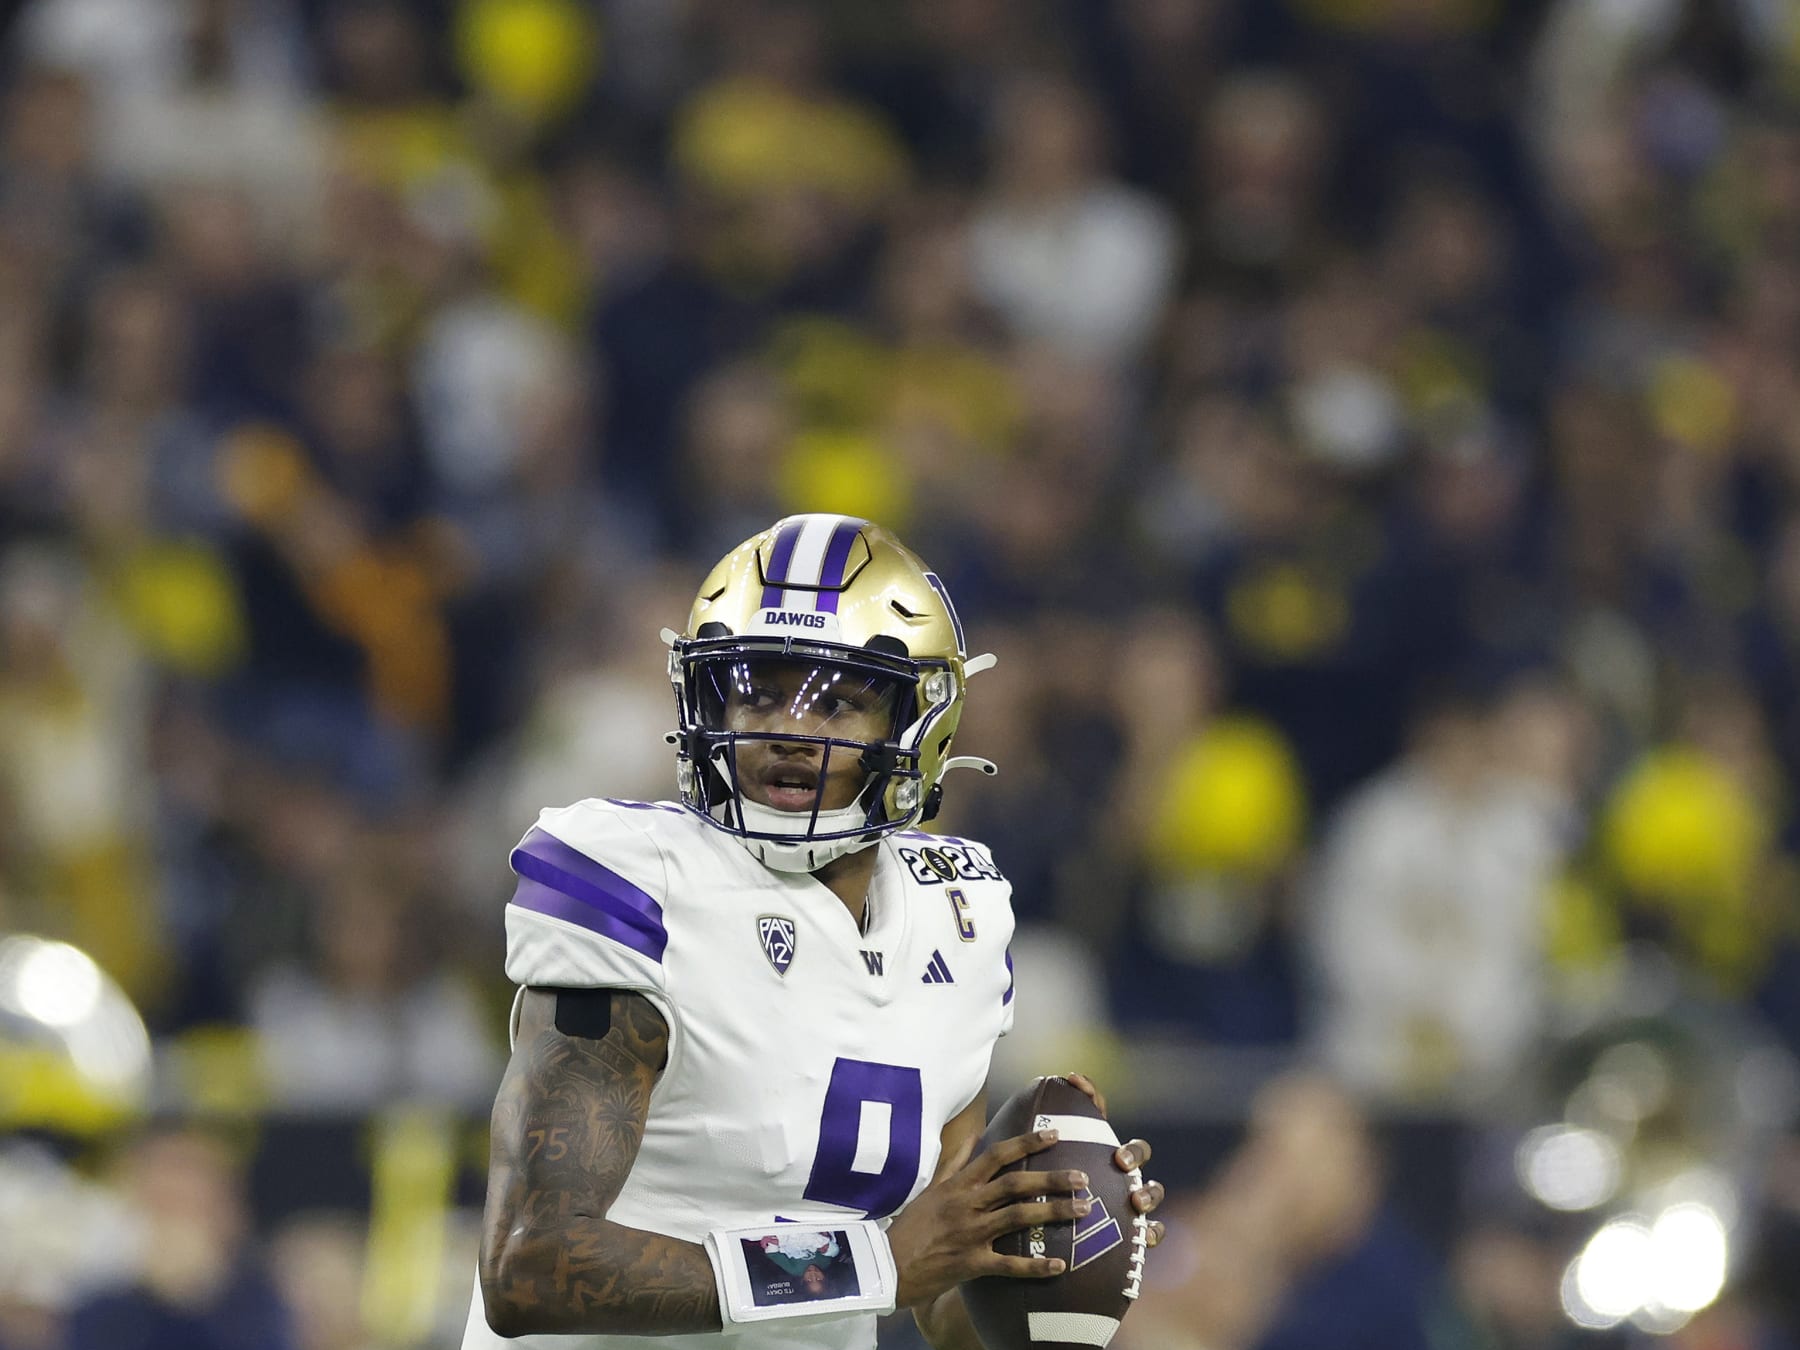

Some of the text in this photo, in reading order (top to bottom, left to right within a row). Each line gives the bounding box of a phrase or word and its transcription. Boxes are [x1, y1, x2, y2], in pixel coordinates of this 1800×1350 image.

[765, 612, 826, 629] DAWGS
[899, 846, 1003, 885] 2024
[945, 887, 978, 942] C
[760, 918, 794, 953] PAC
[770, 942, 789, 963] 12
[859, 950, 883, 976] W
[527, 1128, 569, 1161] 75
